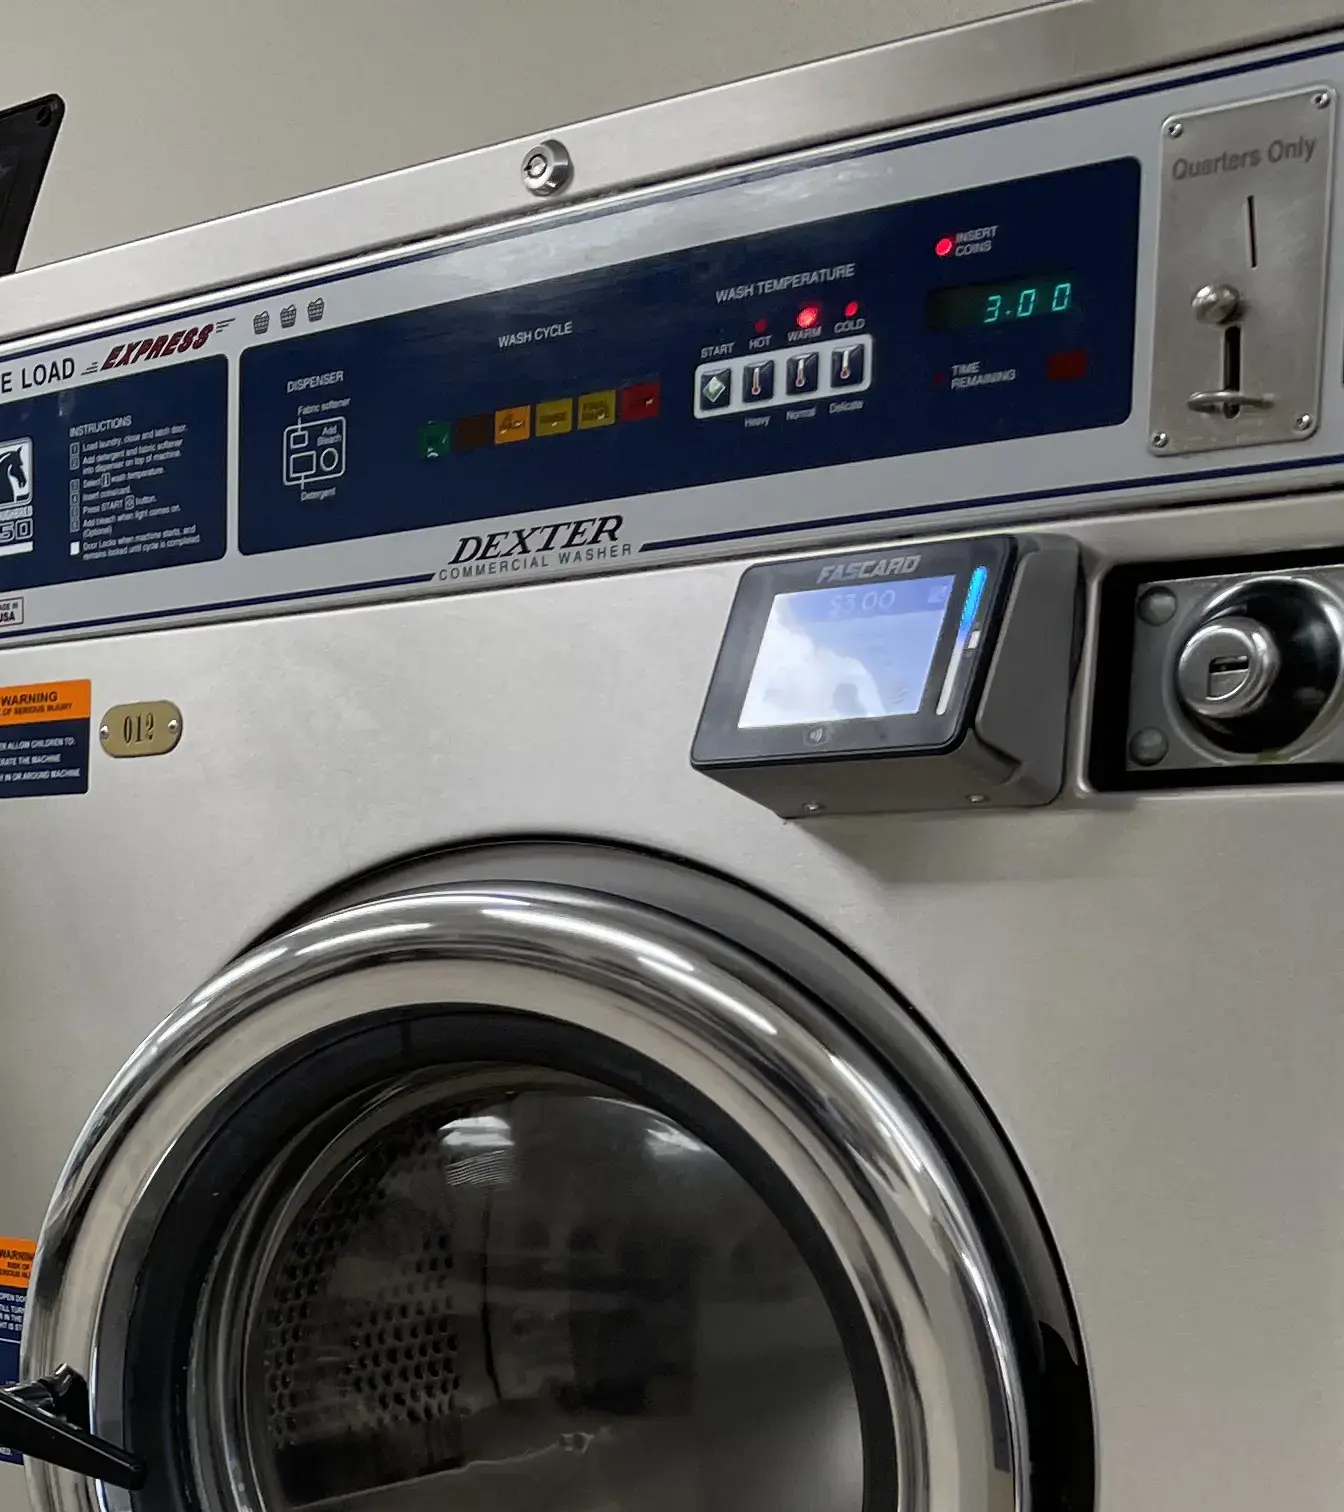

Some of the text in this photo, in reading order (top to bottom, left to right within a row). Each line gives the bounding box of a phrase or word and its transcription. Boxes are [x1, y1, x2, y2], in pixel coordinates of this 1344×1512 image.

[1172, 135, 1317, 181] Quarters Only
[955, 225, 999, 243] INSERT
[954, 240, 993, 257] COINS
[715, 262, 856, 304] WASH TEMPERATURE
[983, 282, 1071, 323] 3.00
[498, 320, 573, 348] WASH CYCLE
[787, 325, 822, 343] WARM
[834, 318, 866, 334] COLD
[100, 324, 214, 371] EXPRESS
[700, 342, 735, 359] START
[748, 335, 772, 350] HOT
[21, 357, 75, 389] LOAD
[950, 369, 1016, 390] REMAINING
[952, 361, 980, 377] TIME
[286, 370, 344, 393] DISPENSER
[69, 415, 132, 438] INSTRUCTIONS
[448, 514, 624, 565] DEXTER
[439, 543, 632, 581] COMMERCIAL WASHER
[816, 554, 922, 585] FASCARD
[0, 691, 58, 707] WARNING
